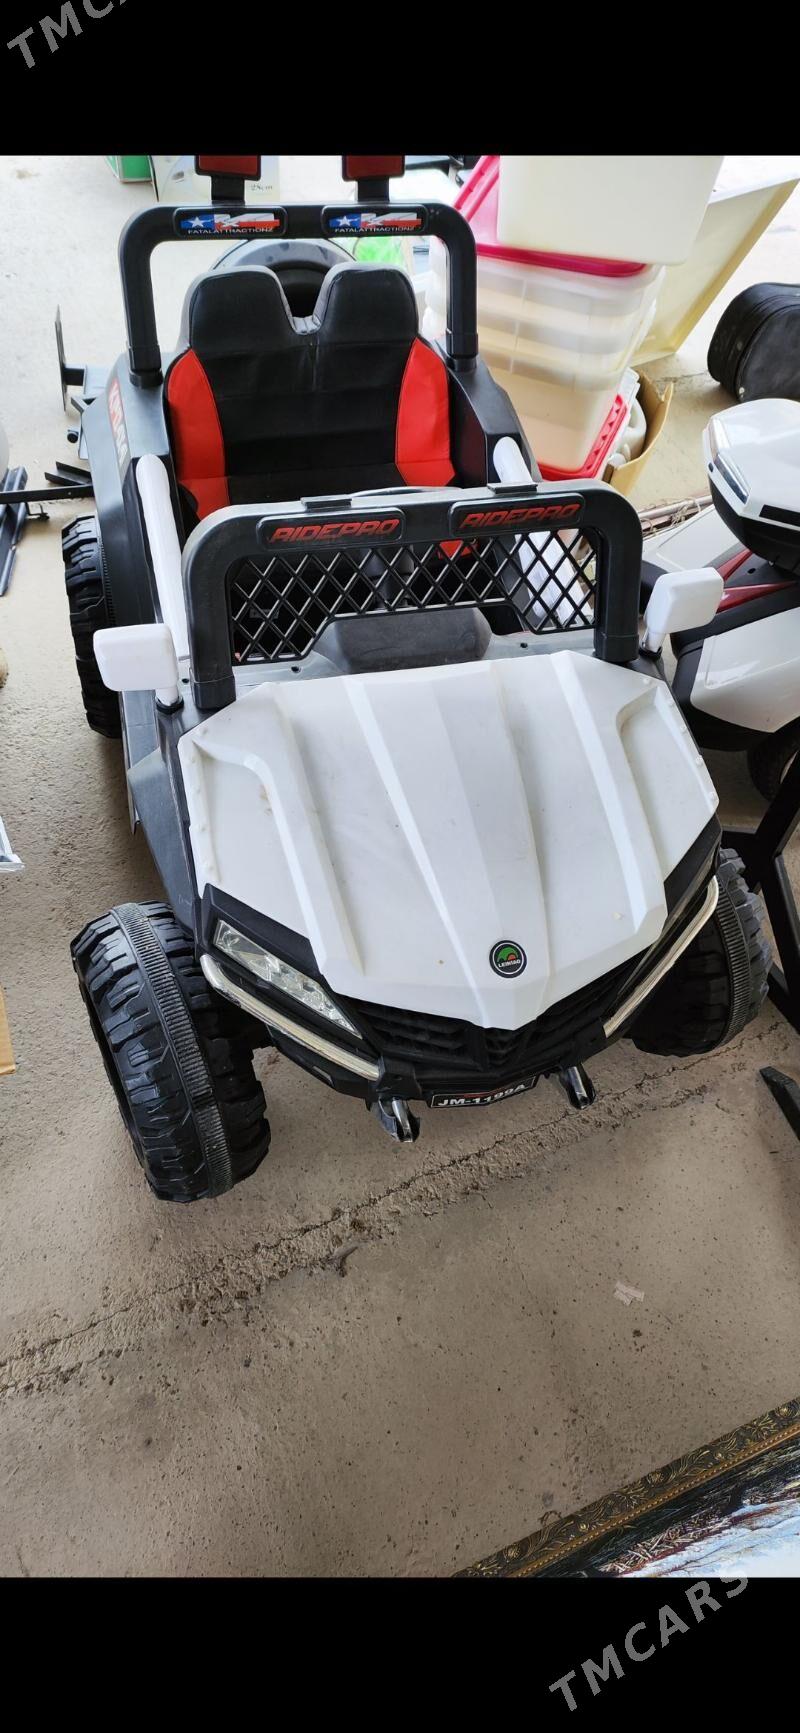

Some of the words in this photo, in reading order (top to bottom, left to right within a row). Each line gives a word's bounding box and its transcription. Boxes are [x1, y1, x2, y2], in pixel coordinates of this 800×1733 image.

[460, 503, 580, 528] RIDEPRO
[268, 518, 400, 544] RIDEPRO
[437, 1084, 526, 1106] JM-1199A
